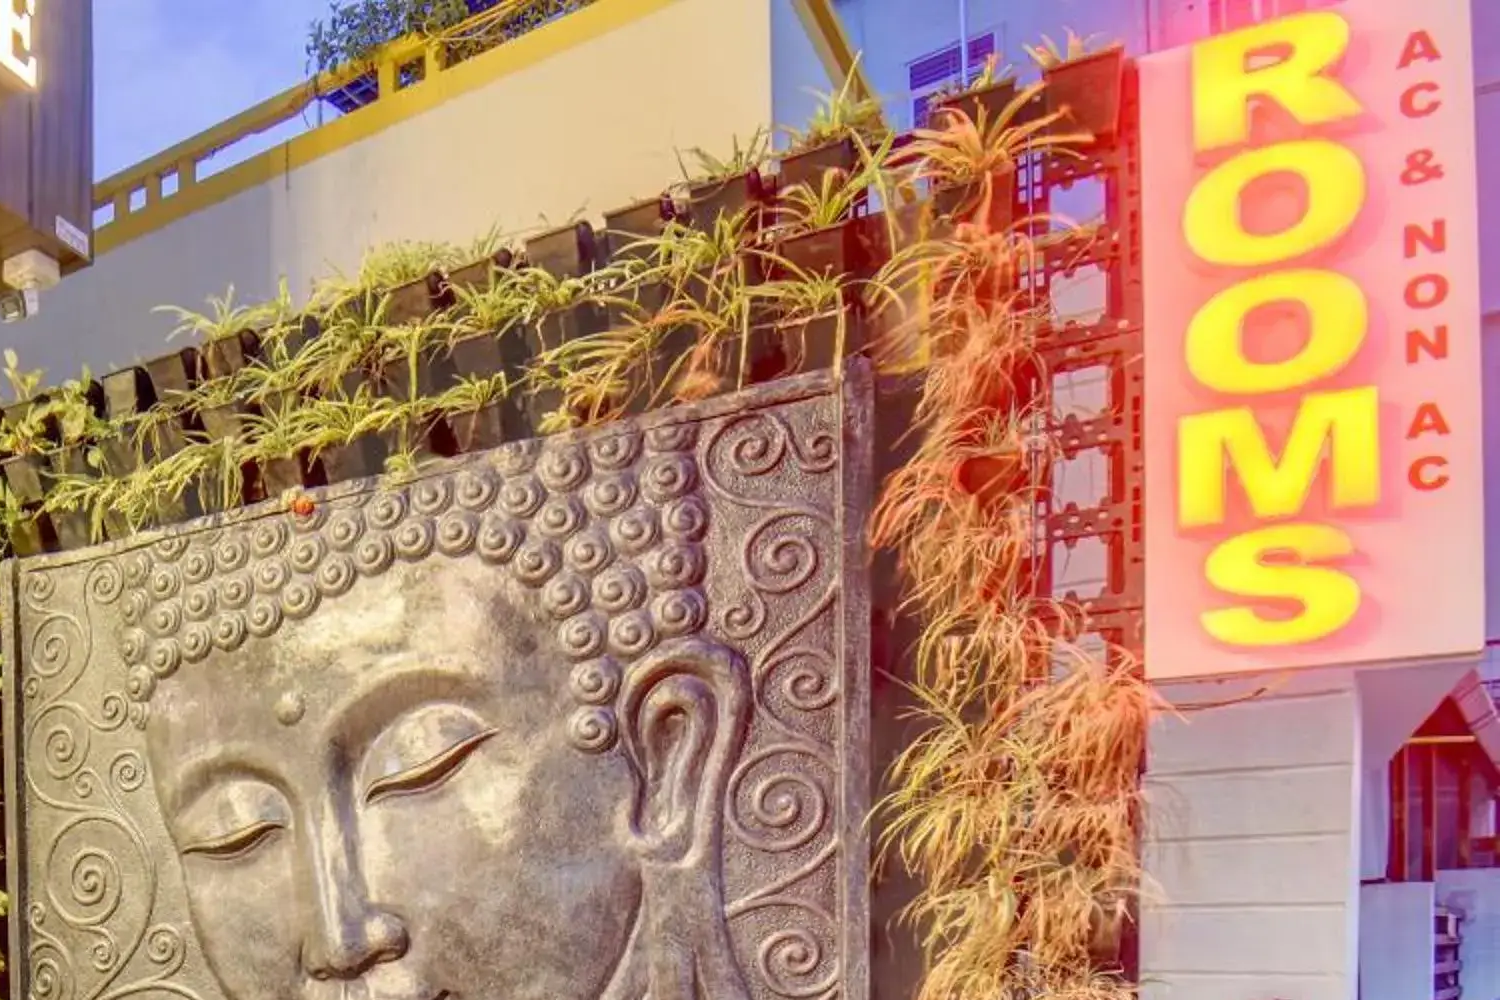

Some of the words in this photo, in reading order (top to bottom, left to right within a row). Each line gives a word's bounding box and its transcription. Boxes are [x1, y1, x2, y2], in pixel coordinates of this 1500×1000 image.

[1396, 29, 1442, 118] AC
[1400, 149, 1444, 186] &
[1178, 11, 1380, 646] ROOMS
[1404, 218, 1449, 364] NON
[1406, 402, 1451, 492] AC
